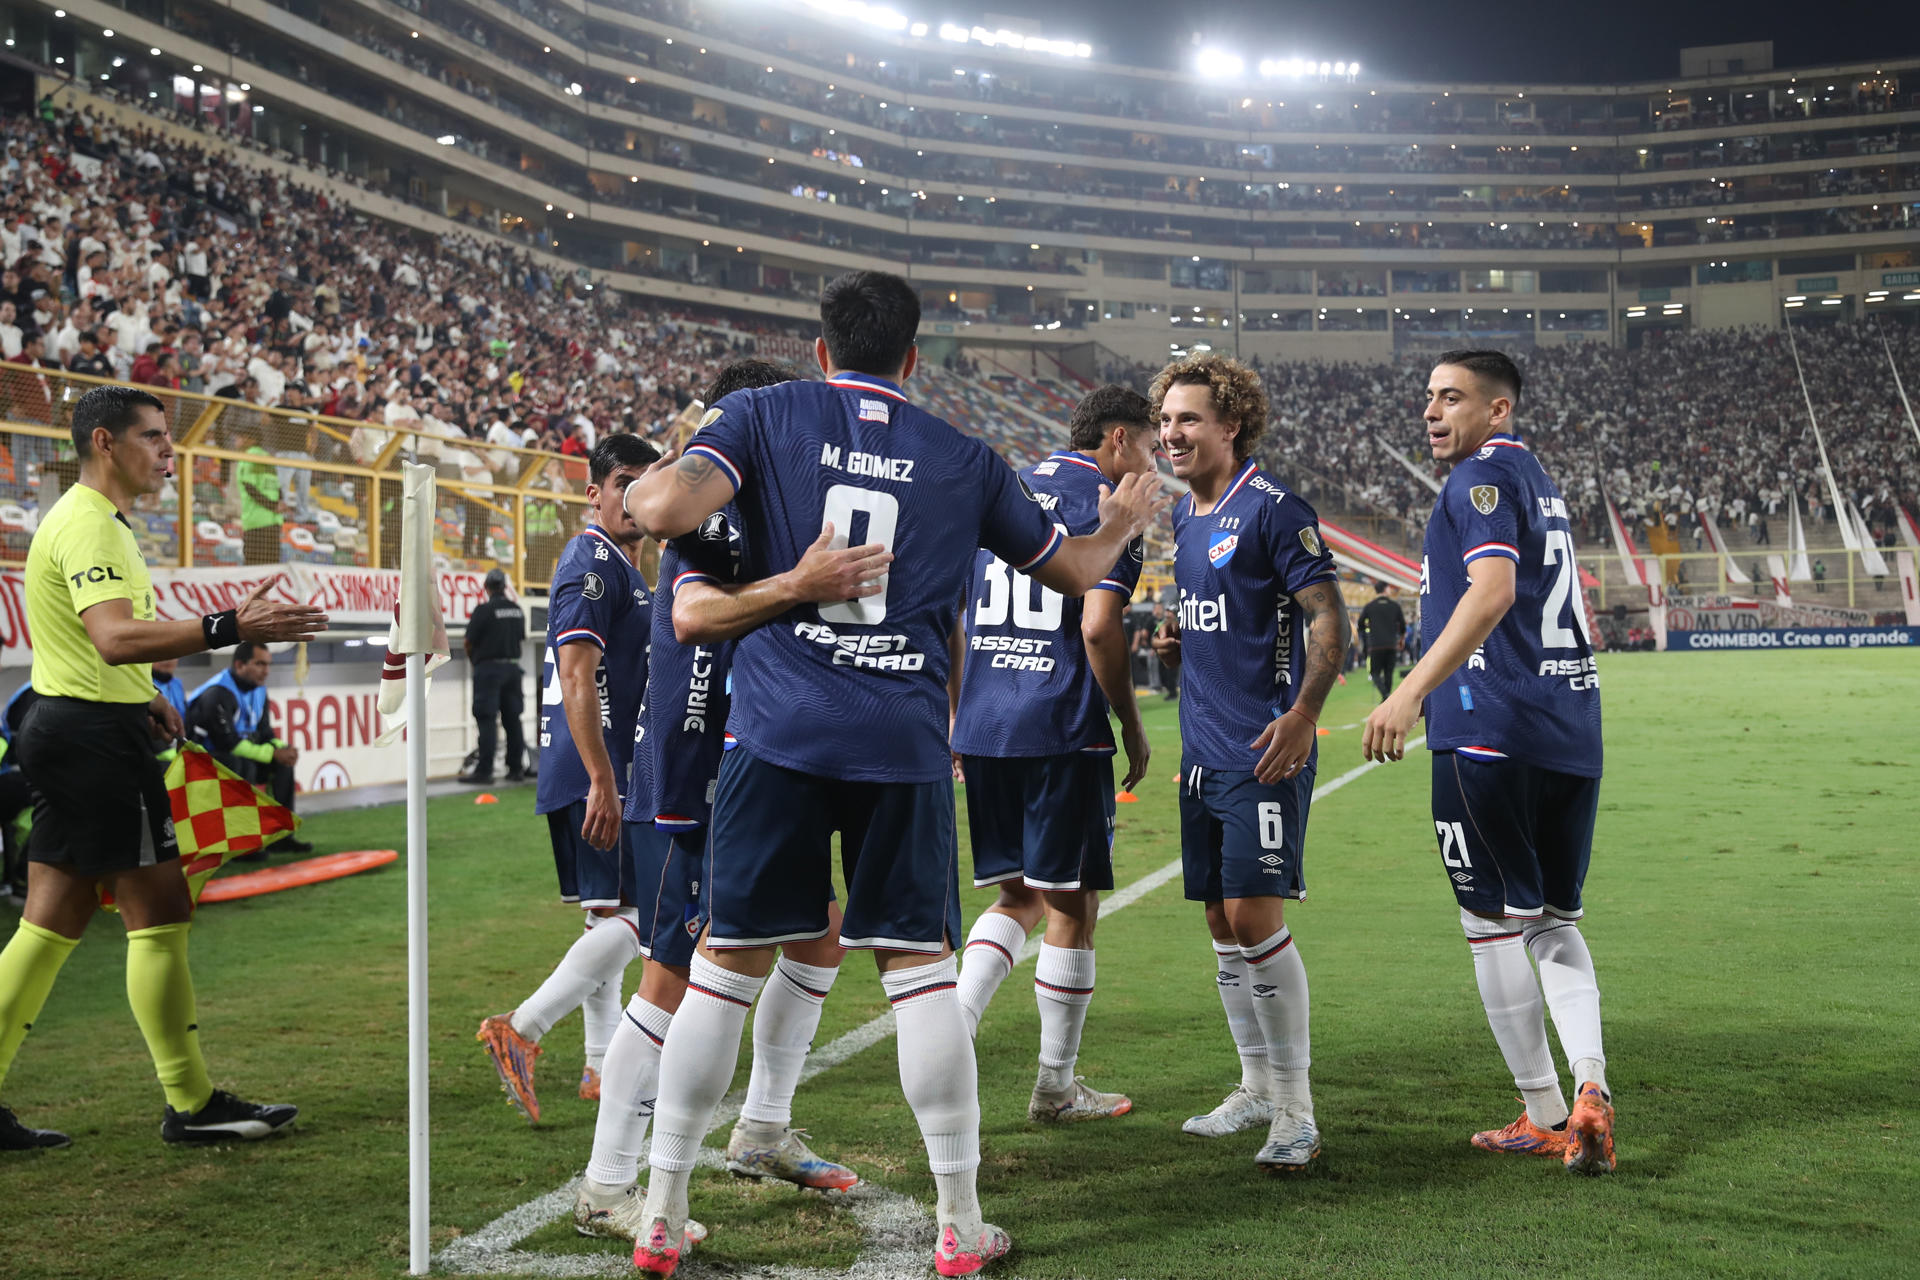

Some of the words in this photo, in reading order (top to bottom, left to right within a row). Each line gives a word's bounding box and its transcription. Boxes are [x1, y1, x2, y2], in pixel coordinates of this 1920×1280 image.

[821, 443, 843, 470] M.
[847, 452, 914, 482] GOMEZ
[1249, 475, 1285, 504] BBVA
[71, 566, 123, 589] TCL
[794, 621, 909, 654] ASSIST
[971, 635, 1052, 654] ASSIST
[1275, 592, 1292, 686] DIRECTV
[1689, 632, 1781, 648] CONMEBOL
[1783, 631, 1822, 647] Cree
[1824, 632, 1846, 645] en
[832, 649, 925, 671] CARD
[991, 653, 1056, 672] CARD
[1538, 655, 1598, 677] ASSIS
[683, 645, 712, 734] DIRECT
[1569, 673, 1600, 691] CA
[1258, 802, 1283, 849] 6
[1435, 820, 1473, 868] 21
[1263, 867, 1281, 875] umbro
